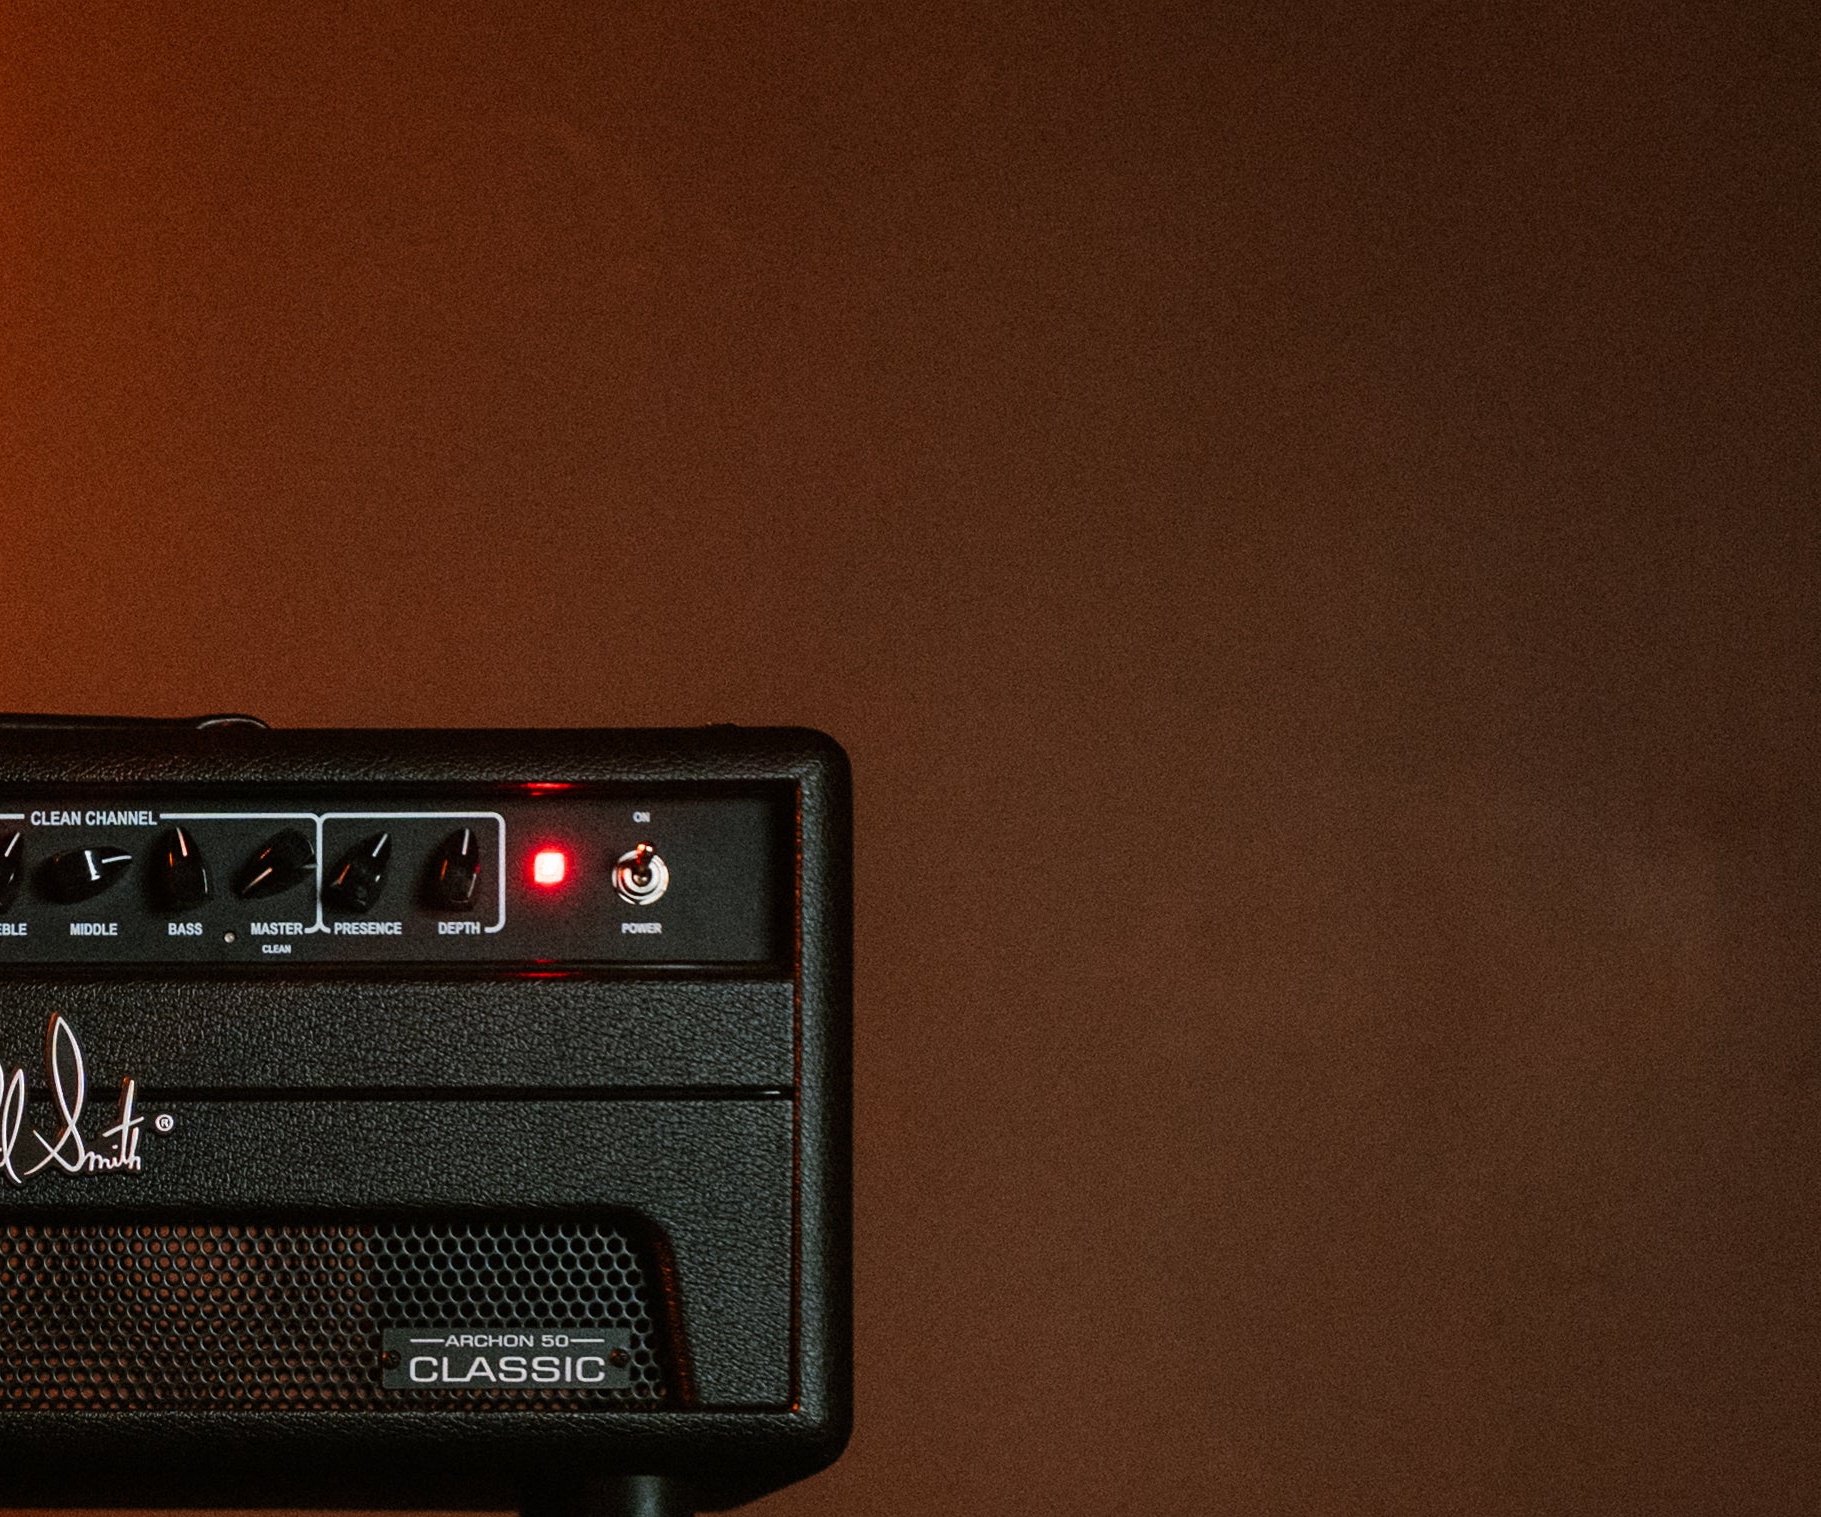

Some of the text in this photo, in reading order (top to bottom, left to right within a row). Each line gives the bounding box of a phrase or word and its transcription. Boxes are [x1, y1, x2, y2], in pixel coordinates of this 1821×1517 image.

[30, 811, 157, 826] CLEAN CHANNEL
[632, 811, 650, 823] ON
[70, 923, 118, 936] MIDDLE
[168, 922, 203, 936] BASS
[250, 922, 304, 936] MASTER
[333, 922, 403, 936] PRESENCE
[438, 921, 481, 935] DEPTH
[621, 922, 662, 934] POWER
[262, 944, 291, 954] CLEAN
[443, 1332, 571, 1350] ARCHON 50
[409, 1356, 605, 1384] CLASSIC
